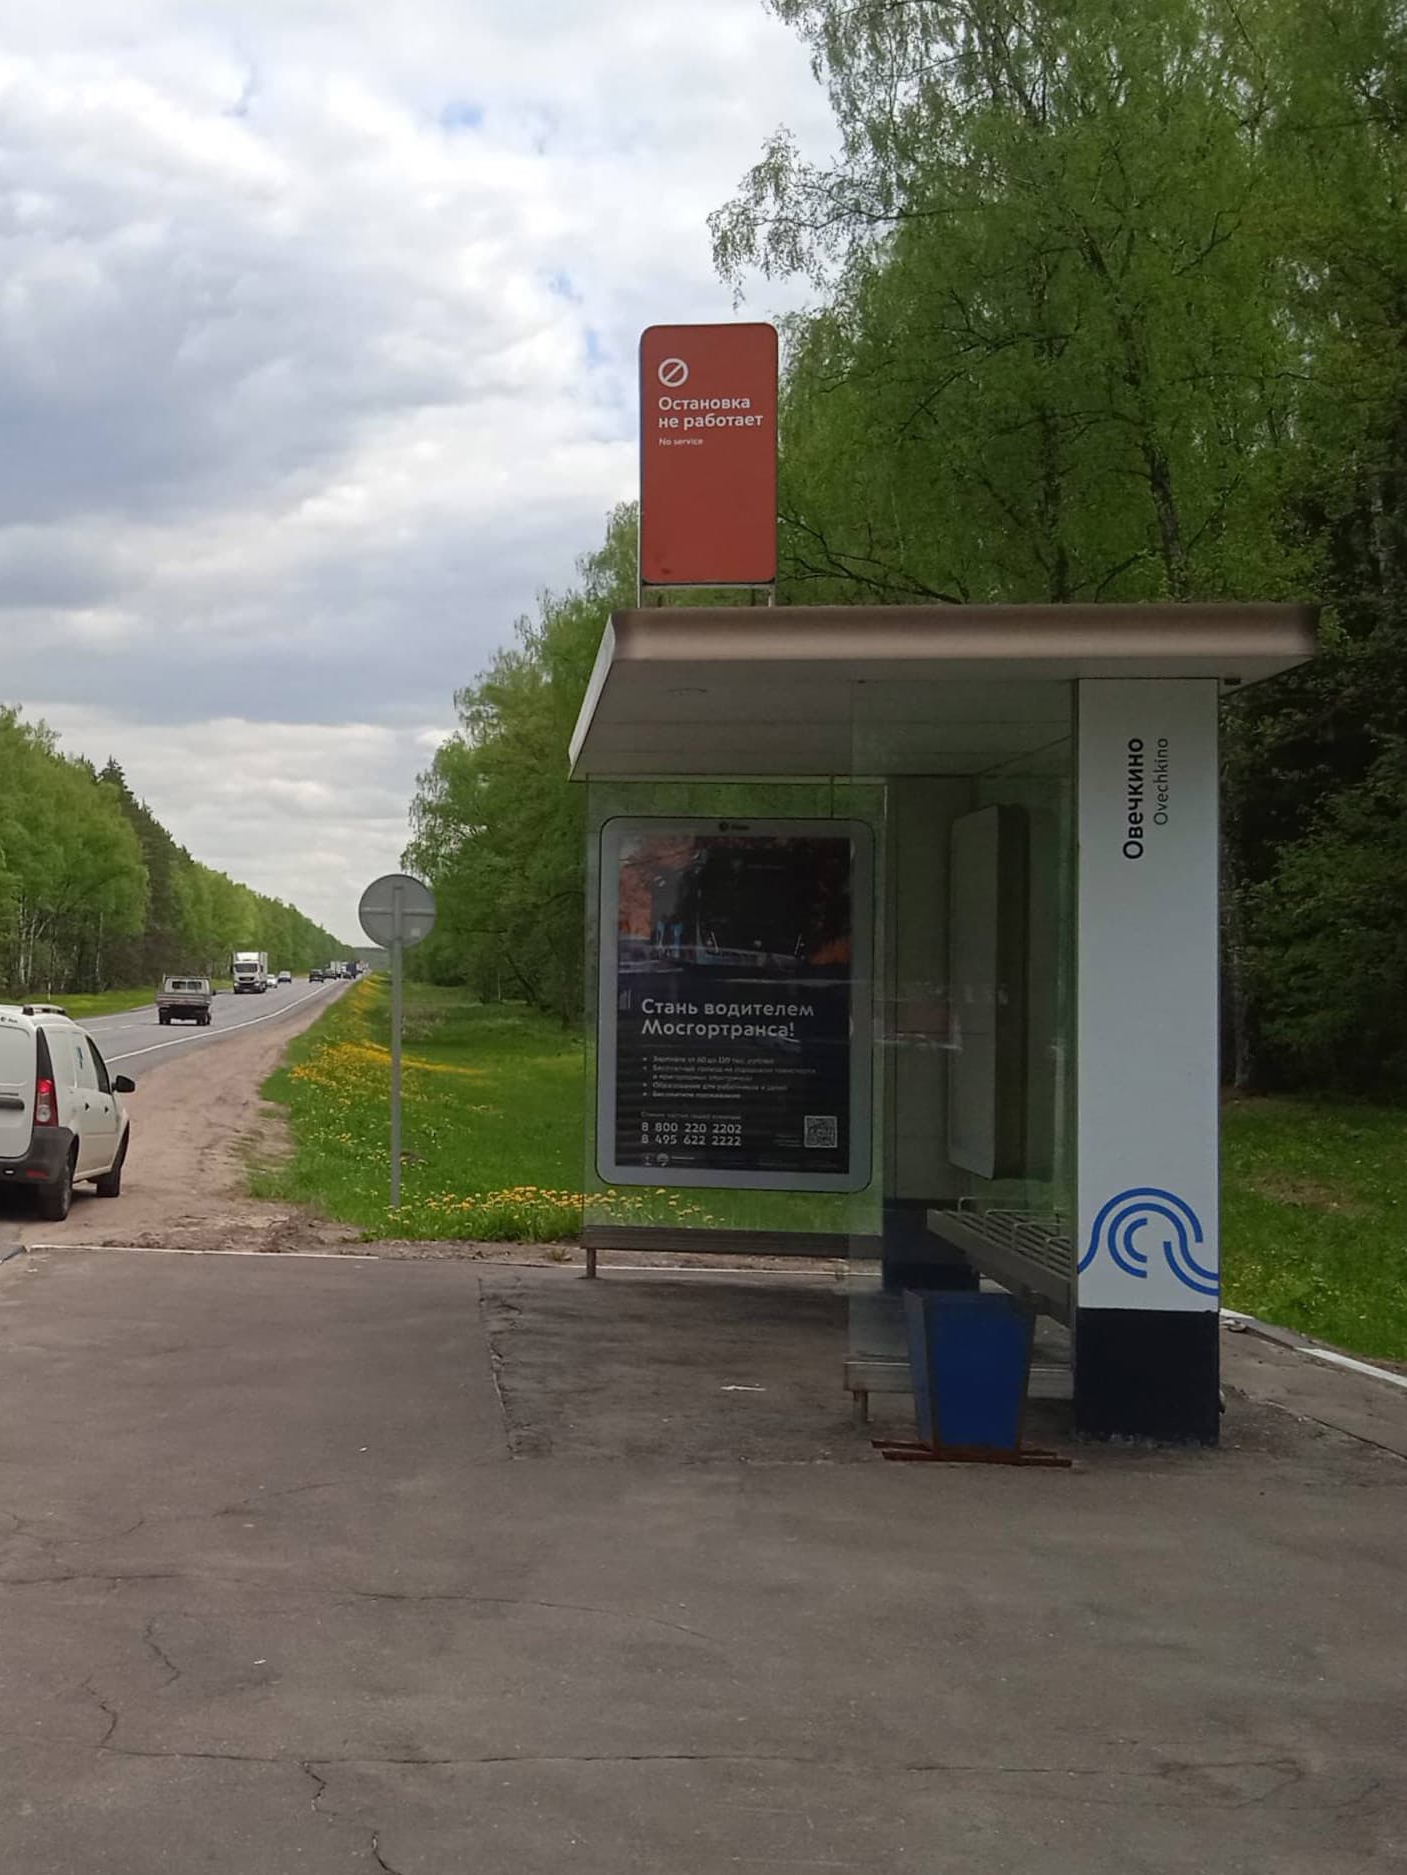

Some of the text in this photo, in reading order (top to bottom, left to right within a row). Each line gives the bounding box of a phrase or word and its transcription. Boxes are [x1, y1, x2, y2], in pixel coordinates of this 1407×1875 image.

[658, 396, 751, 411] Остановка
[658, 412, 764, 431] не работает
[658, 437, 704, 446] No service
[1153, 737, 1169, 826] Ovechkino
[1122, 738, 1144, 860] Овечкино
[641, 999, 815, 1018] Стань водителем
[641, 1019, 795, 1039] Мосгортранса!
[641, 1122, 742, 1134] 8 800 220 2202
[641, 1134, 742, 1146] 8 495 622 2222
